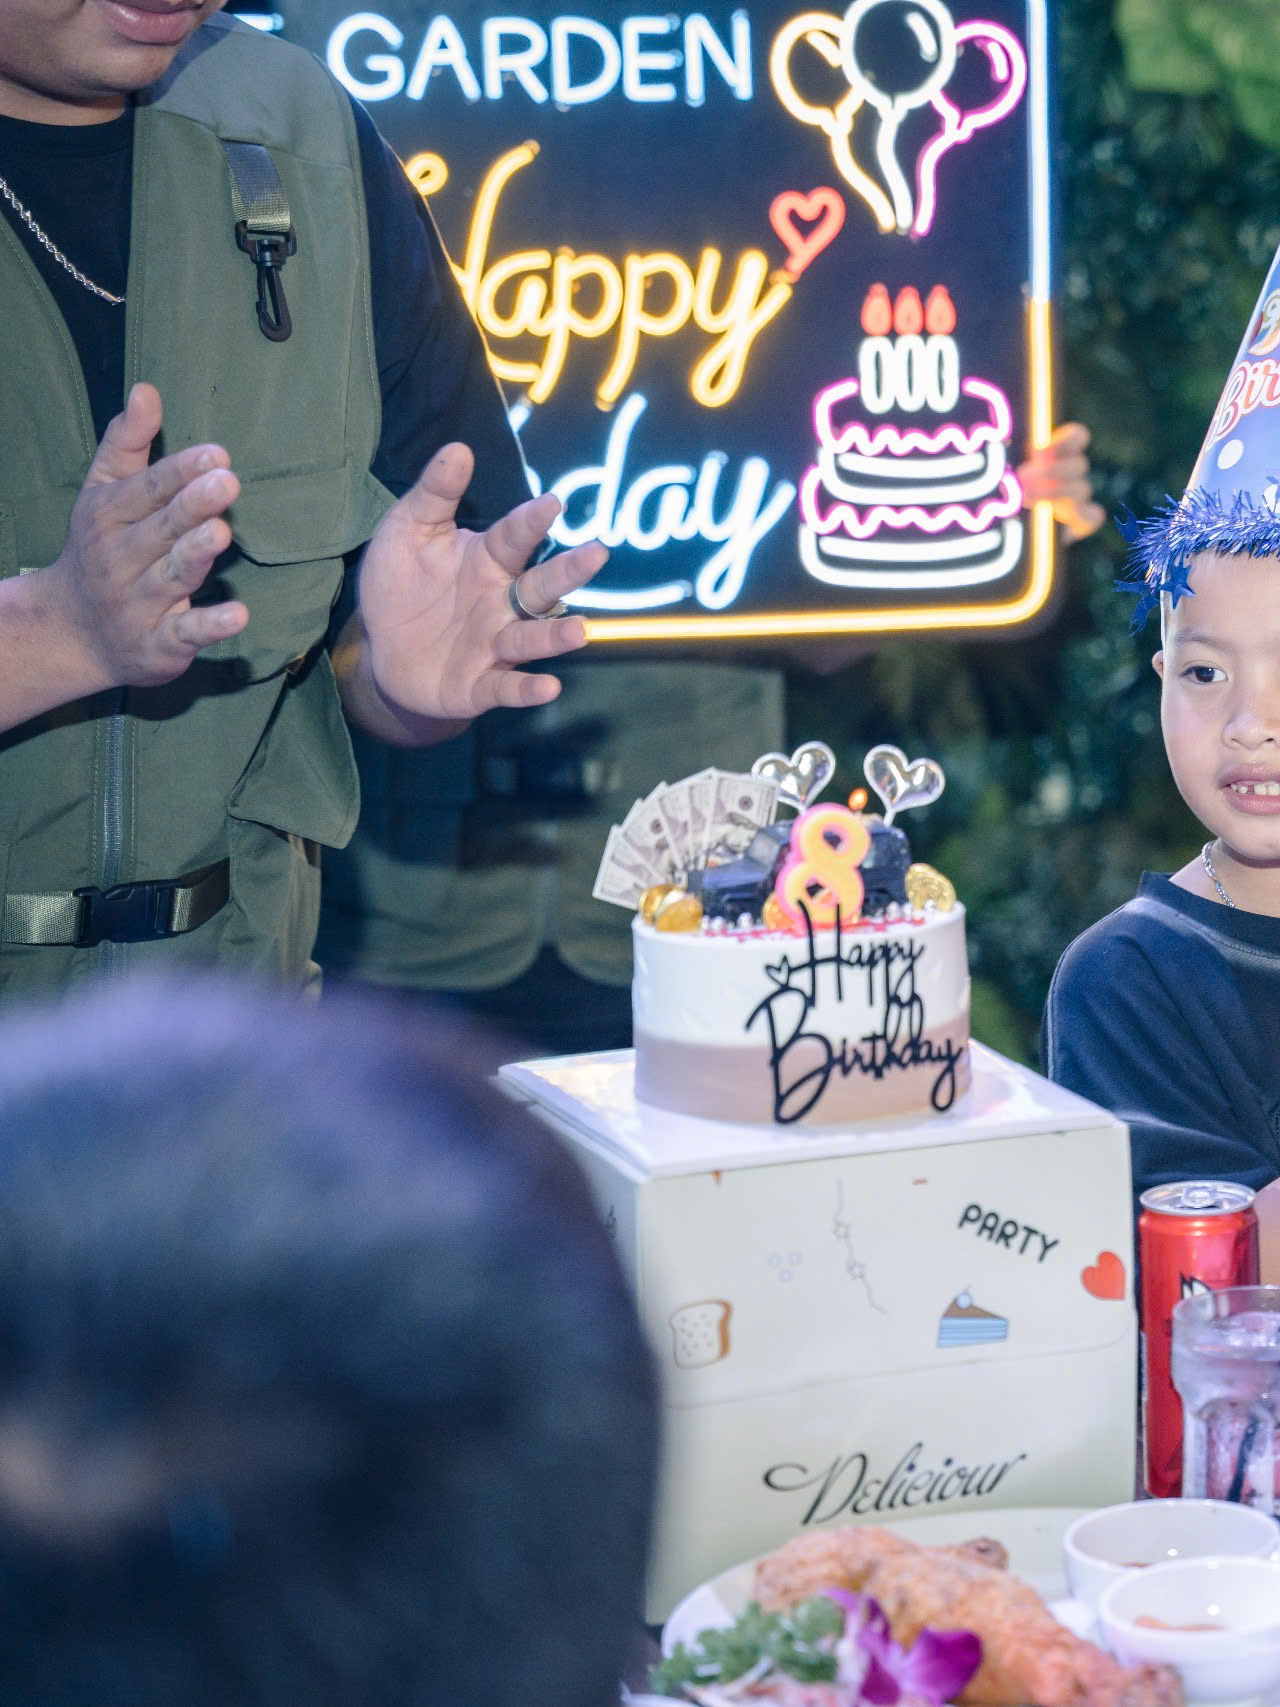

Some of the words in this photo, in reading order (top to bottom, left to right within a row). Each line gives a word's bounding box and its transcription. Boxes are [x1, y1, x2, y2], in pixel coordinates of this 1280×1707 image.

[326, 12, 755, 106] GARDEN
[508, 393, 797, 609] day
[788, 899, 926, 1008] Happy
[745, 987, 963, 1125] Birthday
[957, 1203, 1060, 1264] PARTY
